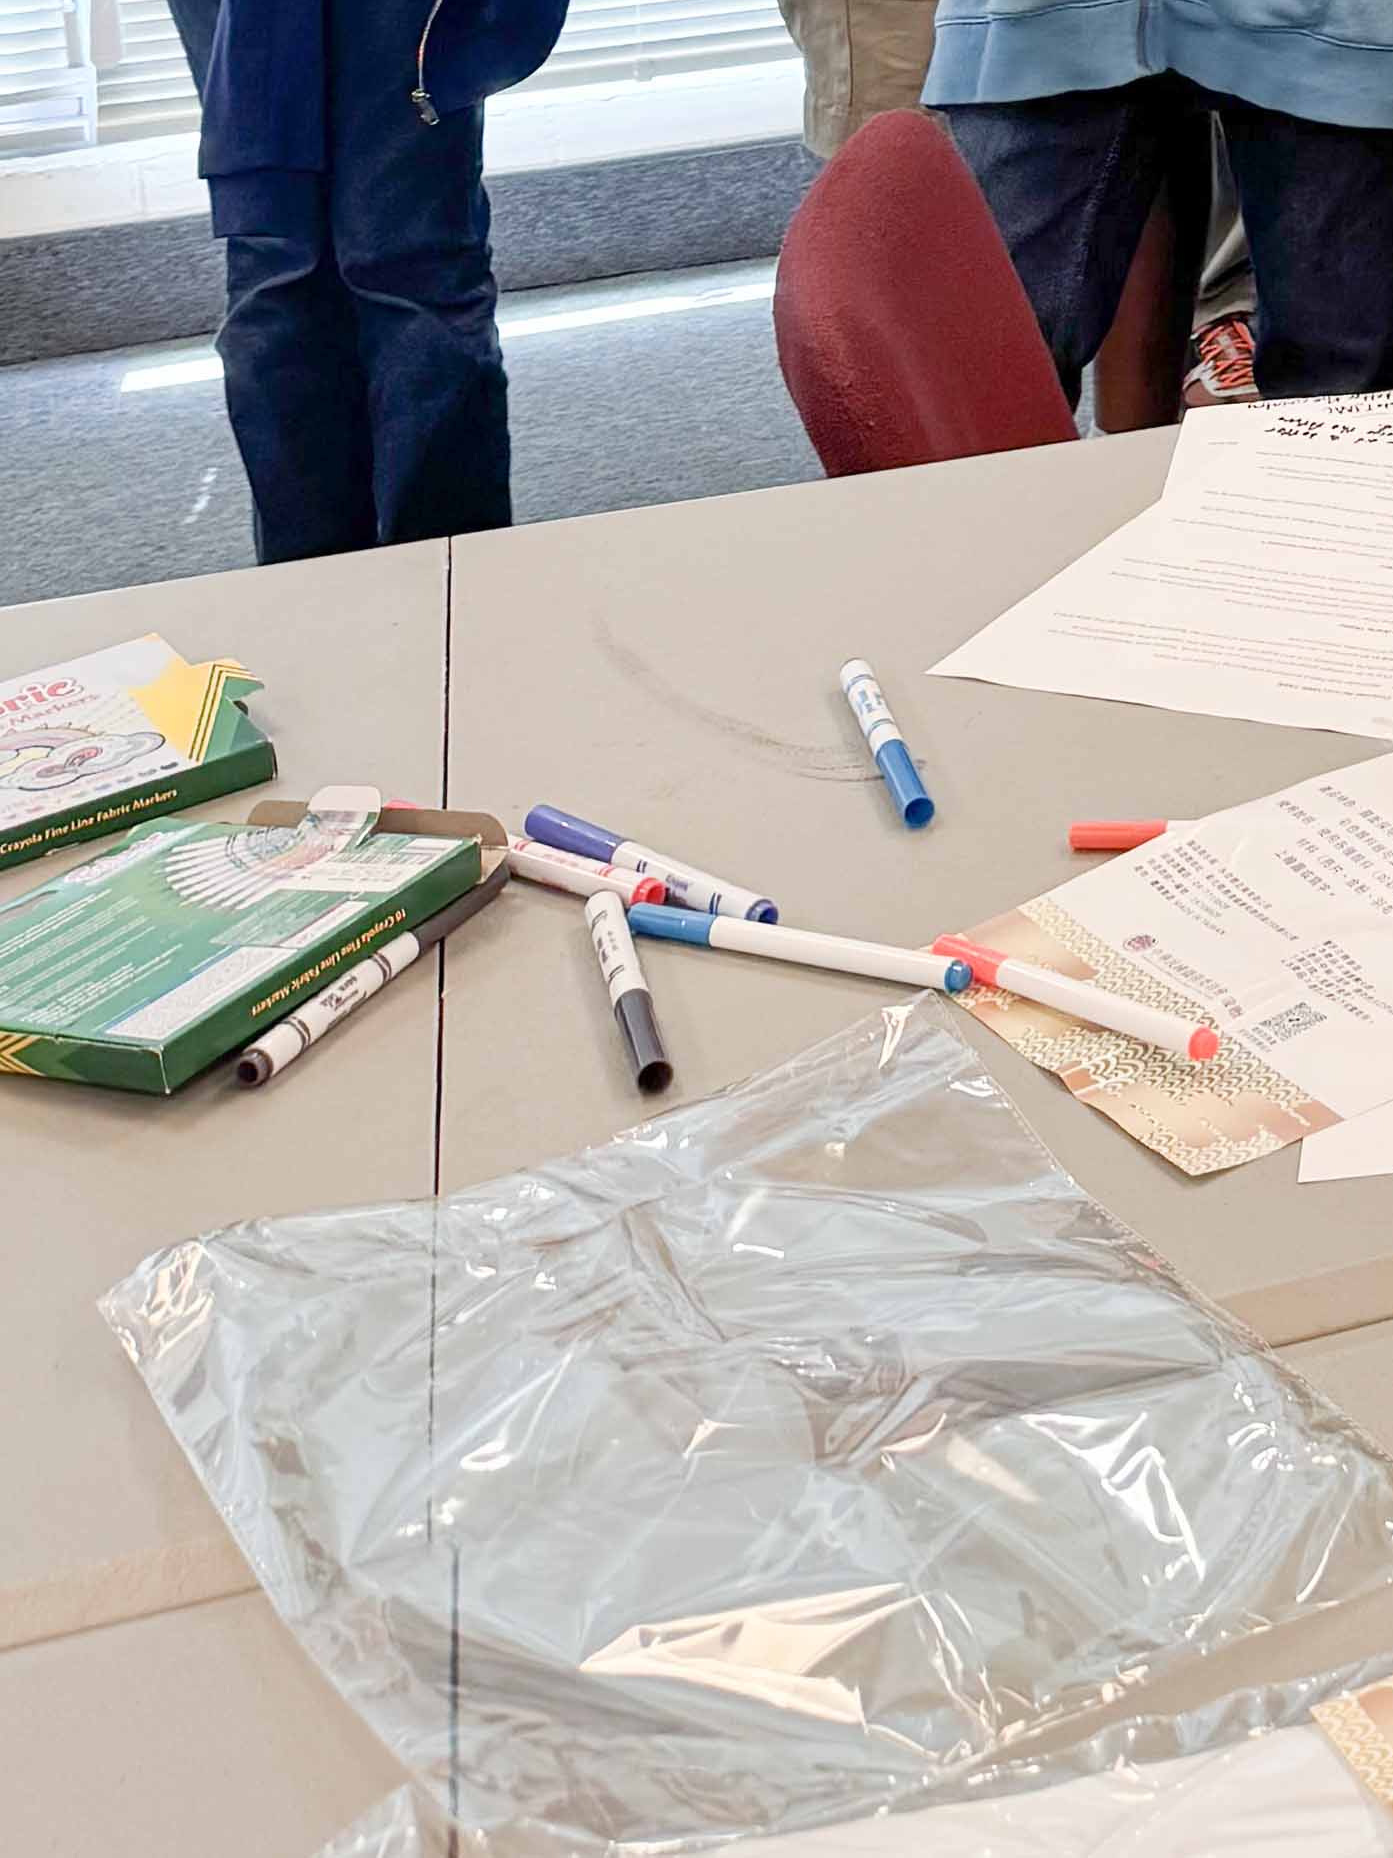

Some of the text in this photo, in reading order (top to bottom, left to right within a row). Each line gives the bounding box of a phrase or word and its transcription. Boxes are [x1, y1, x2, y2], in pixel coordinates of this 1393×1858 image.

[0, 787, 178, 855] Crayola Fine Line Fabric Markers
[361, 915, 394, 943] Crayola
[341, 936, 361, 956] Fine
[320, 952, 341, 971] Line
[291, 965, 320, 990] Fabric
[252, 986, 290, 1018] Markers
